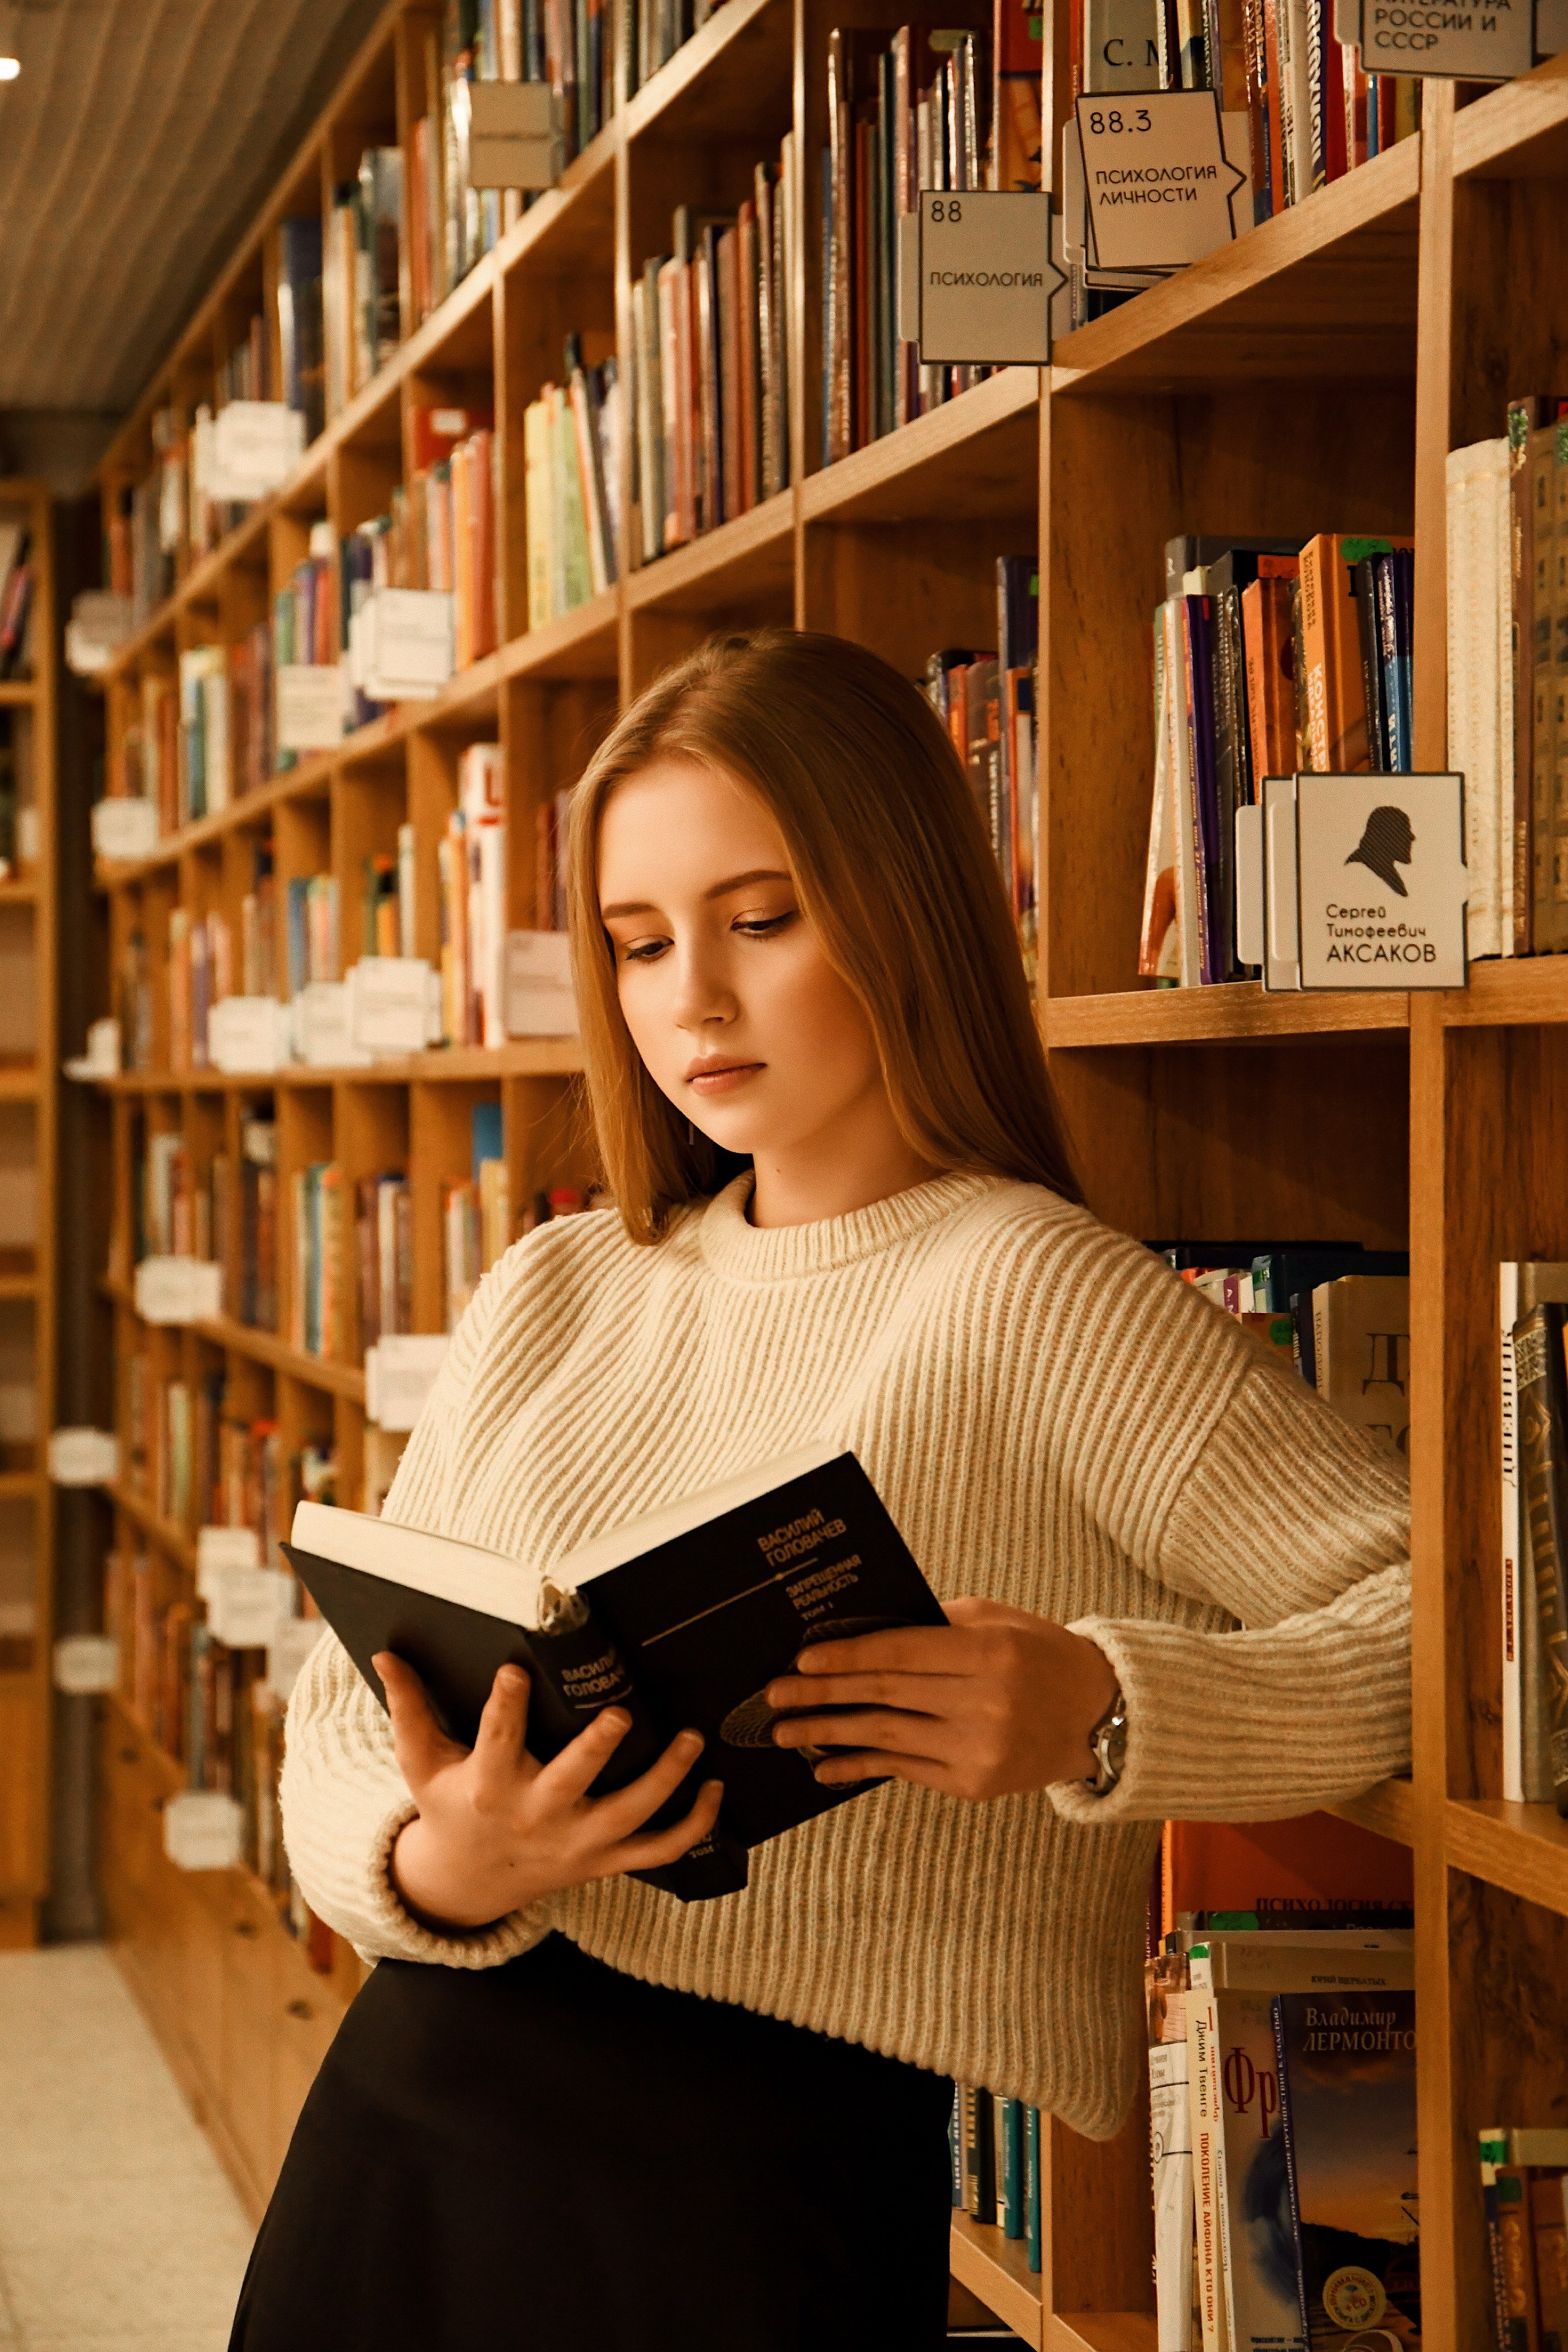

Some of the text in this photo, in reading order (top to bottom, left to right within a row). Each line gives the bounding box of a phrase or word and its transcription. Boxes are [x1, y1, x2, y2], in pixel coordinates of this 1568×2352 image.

[1375, 9, 1496, 31] РОССИИ И
[1104, 39, 1133, 66] С.
[1375, 31, 1438, 50] СССР
[1090, 110, 1152, 134] 88.3
[1096, 165, 1217, 184] ПСИХОЛОГИЯ
[1099, 188, 1197, 206] ЛИЧНОСТИ
[932, 200, 962, 222] 88
[930, 272, 1043, 287] ПСИХОЛОГИЯ
[1326, 903, 1386, 919] Сергей
[1327, 923, 1427, 938] Тимофеевич
[1327, 943, 1436, 963] АКСАКОВ
[1502, 1327, 1517, 1488] ДНЕВНИК
[758, 1507, 825, 1552] ВАСИЛИЙ
[766, 1518, 846, 1567] ГОЛОВАЧЕВ
[786, 1554, 862, 1598] ЗАПРЕЩЕННАЯ
[793, 1573, 859, 1610] РЕАЛЬНОСТЬ
[801, 1605, 825, 1621] ТОМ
[1338, 1976, 1386, 1986] ЩЕРБАТЫХ
[1305, 2007, 1396, 2029] Владимир
[1196, 2020, 1207, 2062] Джим
[1273, 2007, 1283, 2059] СЧАСТЬЮ
[1302, 2030, 1415, 2051] ЛЕРМОНТО
[1199, 2067, 1208, 2117] Твенге
[1225, 2047, 1278, 2139] Фр
[1279, 2072, 1290, 2148] ПУТЕШЕСТВИЕ
[1200, 2133, 1212, 2207] ПОКОЛЕНИЕ
[1204, 2211, 1213, 2265] АЙФОНА
[1205, 2269, 1214, 2293] КТО
